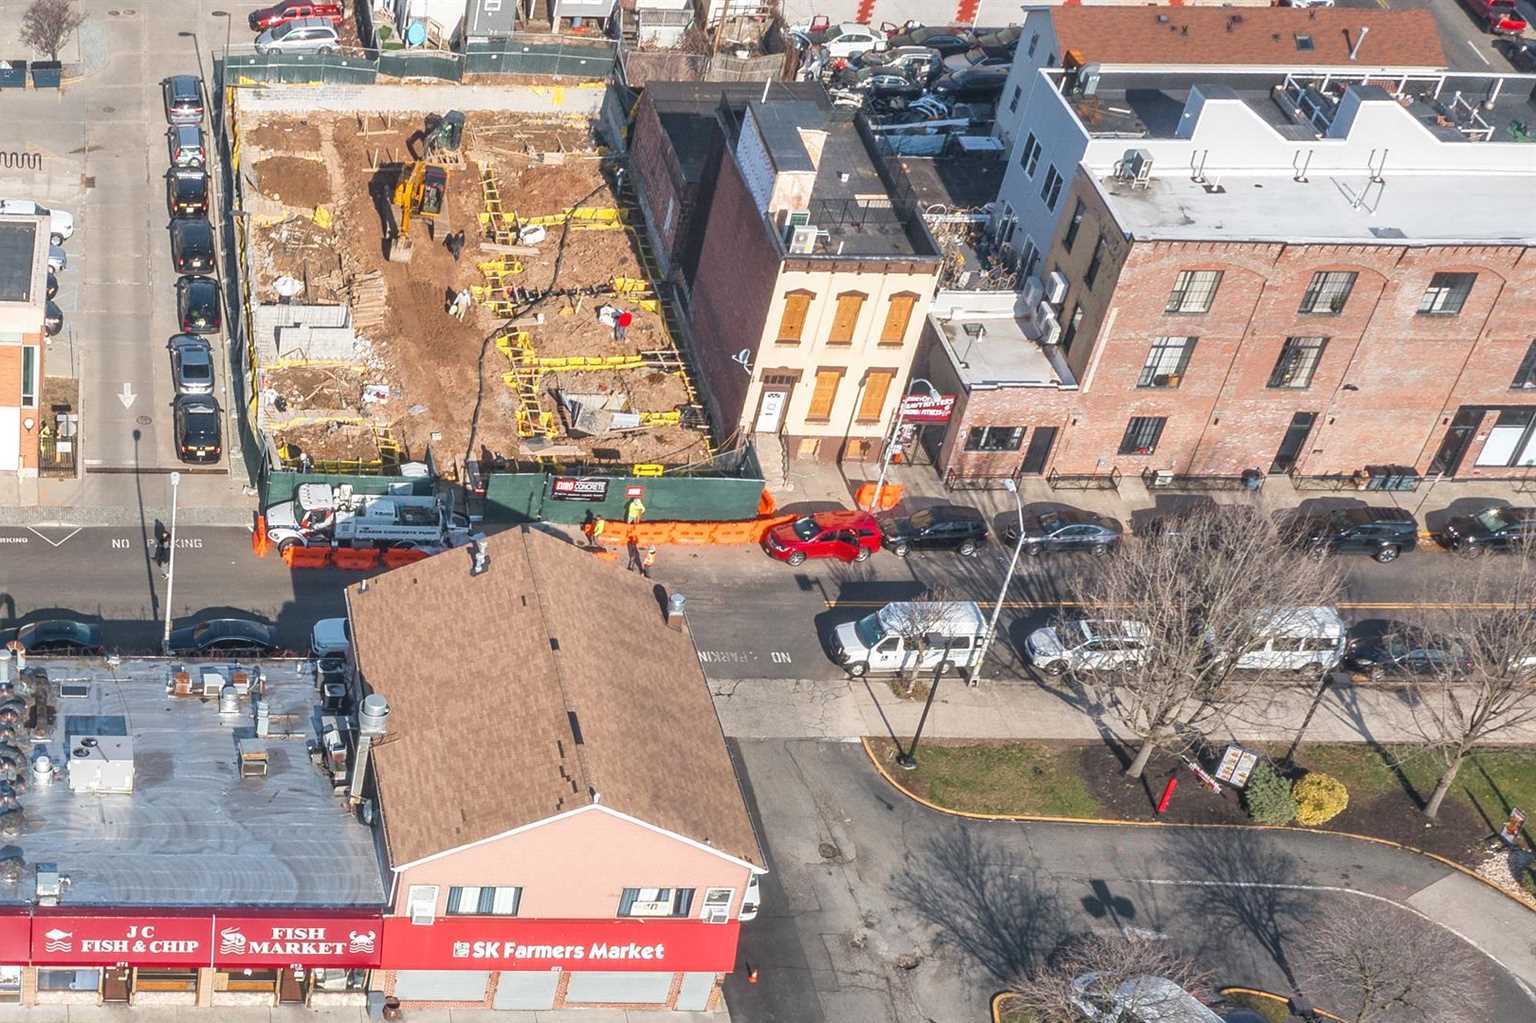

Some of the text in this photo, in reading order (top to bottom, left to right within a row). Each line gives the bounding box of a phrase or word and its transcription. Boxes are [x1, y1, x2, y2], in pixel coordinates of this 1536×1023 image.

[111, 539, 203, 548] NO PKING
[771, 652, 792, 663] NO
[127, 926, 155, 938] J C
[272, 928, 325, 940] FISH
[80, 940, 199, 954] FISH & CHIP
[249, 942, 347, 955] MARKET
[473, 941, 665, 960] SK Farmers Market
